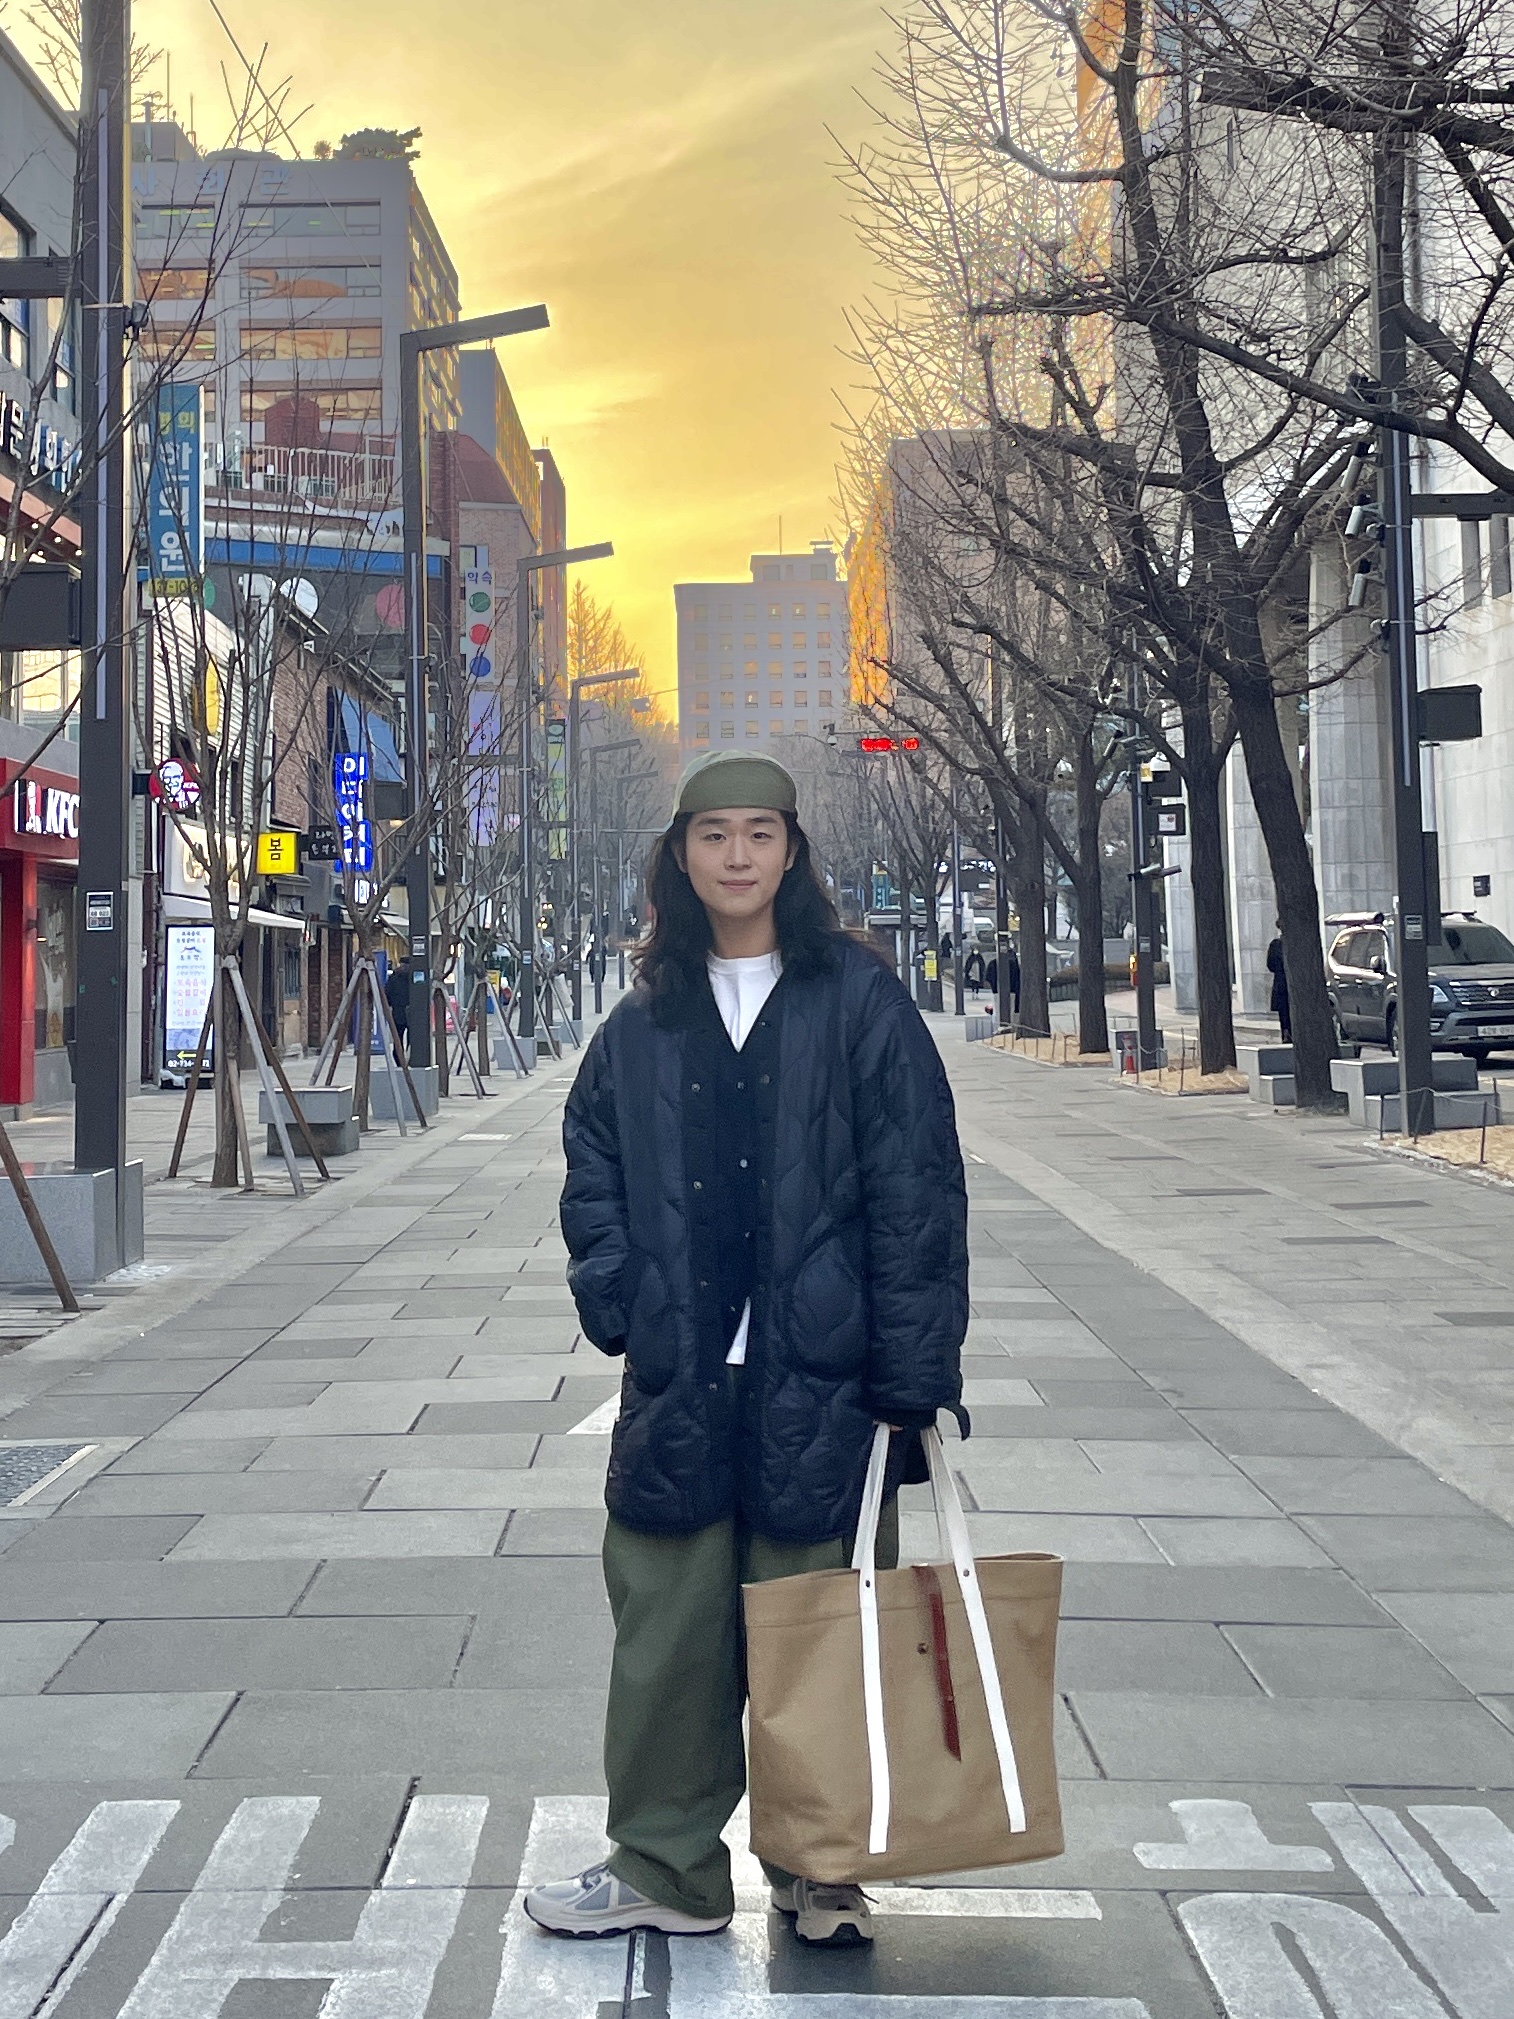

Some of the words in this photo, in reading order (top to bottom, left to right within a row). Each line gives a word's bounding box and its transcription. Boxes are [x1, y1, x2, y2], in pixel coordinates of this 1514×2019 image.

[159, 441, 190, 572] 한의원
[46, 788, 80, 838] KFC
[267, 837, 284, 861] 봄
